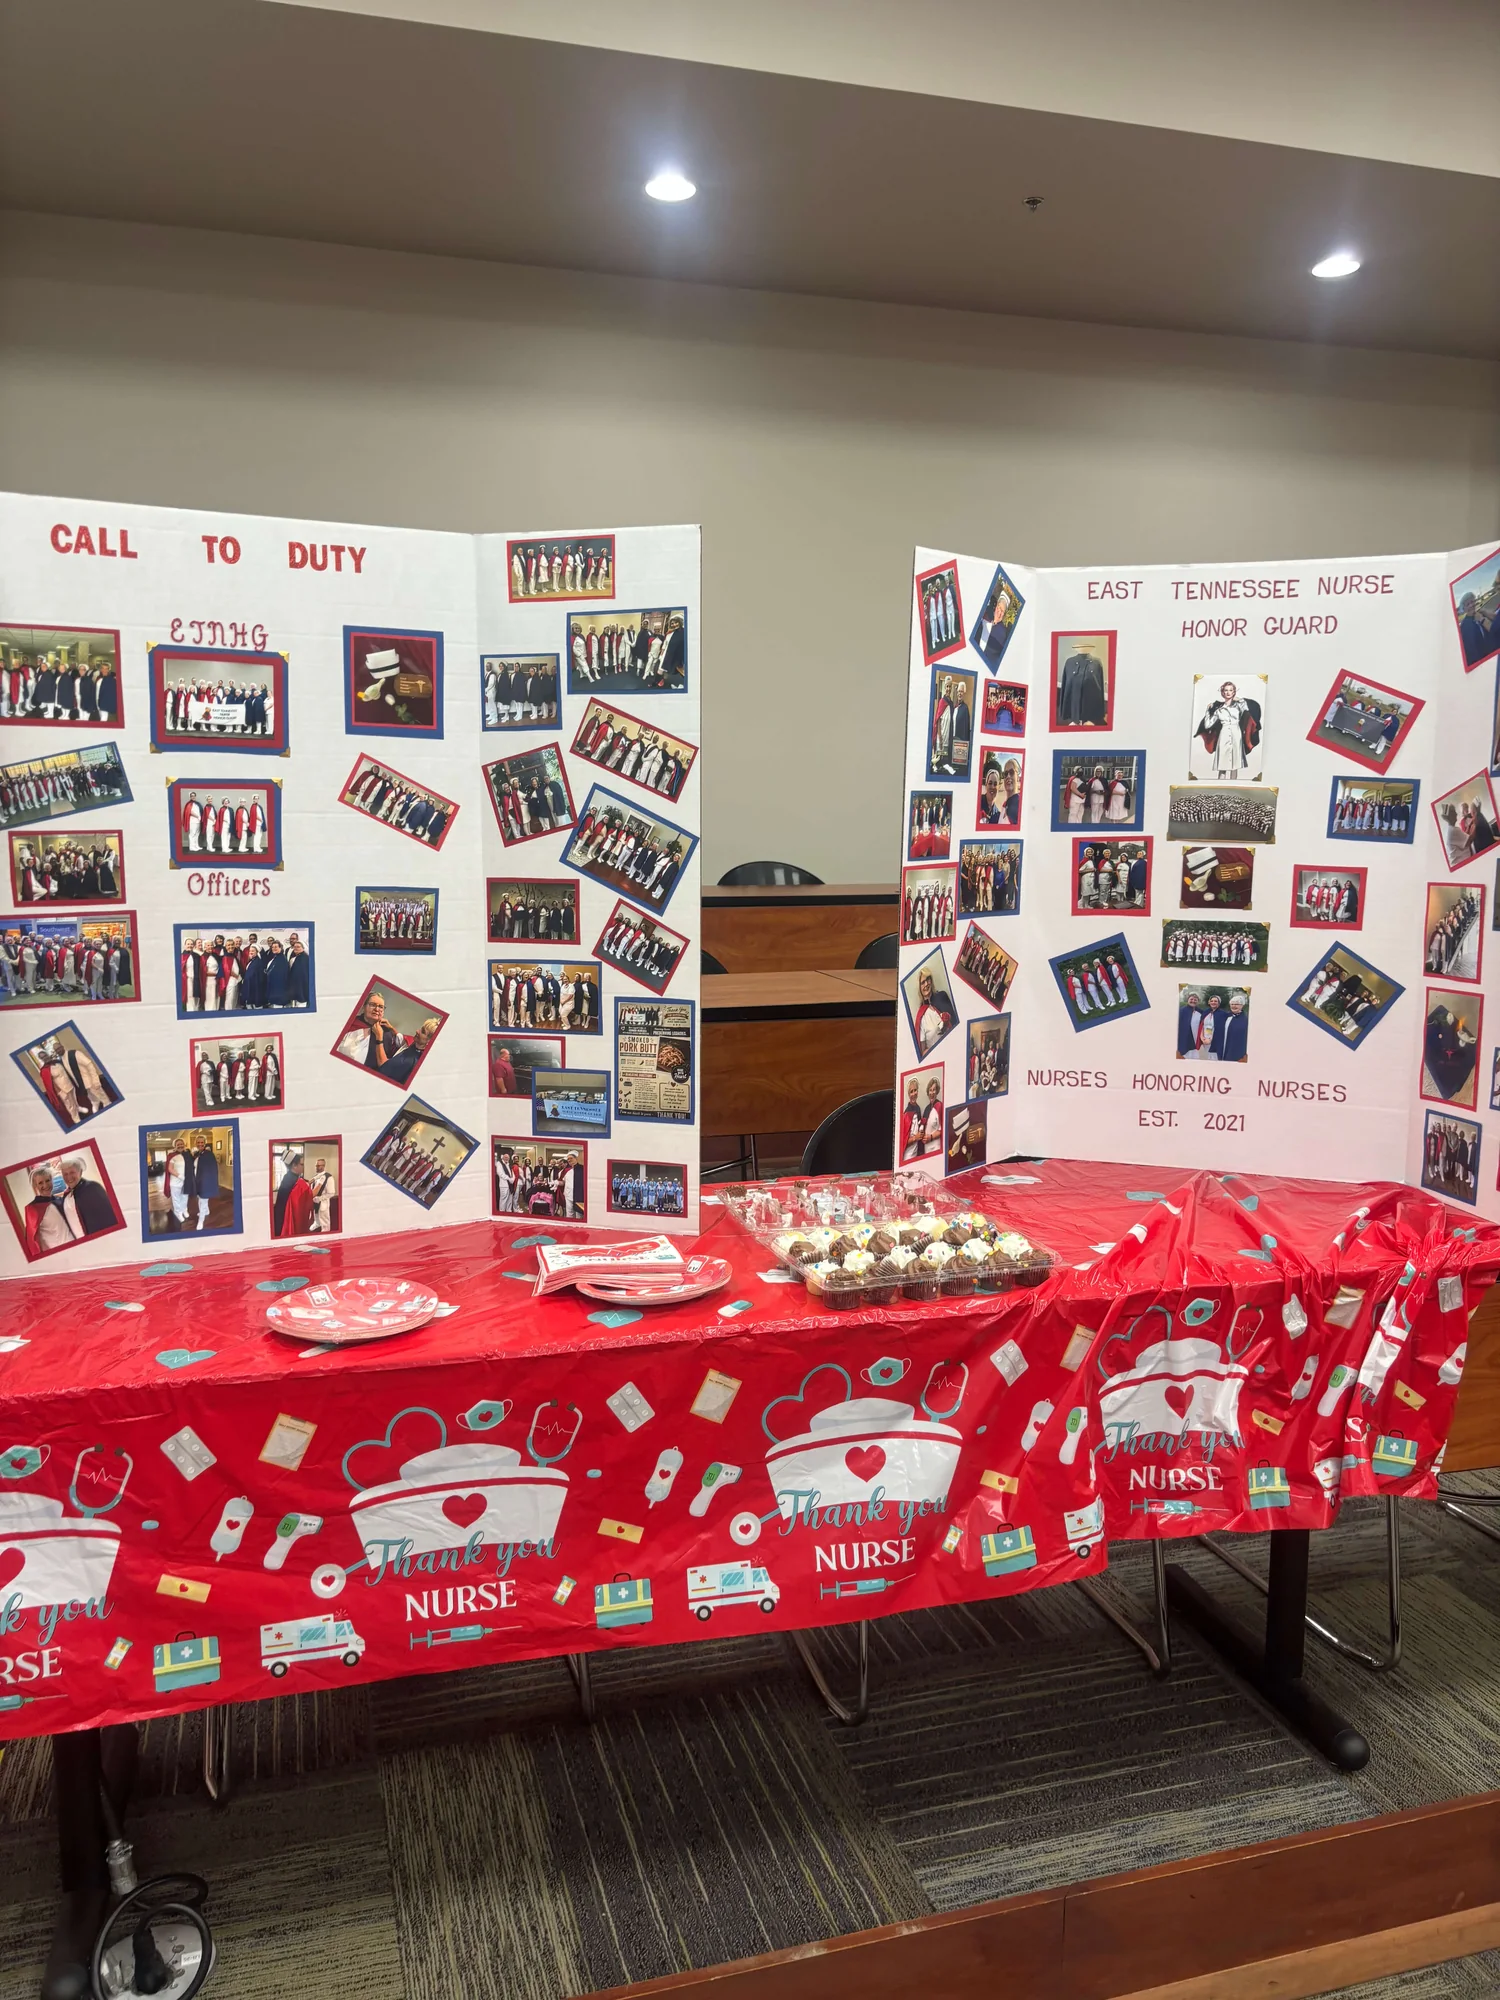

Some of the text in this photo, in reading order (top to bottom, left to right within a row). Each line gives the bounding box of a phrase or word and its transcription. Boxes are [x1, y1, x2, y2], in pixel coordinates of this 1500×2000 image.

[50, 523, 367, 574] CALL TO DUTY
[1087, 574, 1395, 601] EAST TENNESSEE NURSE
[170, 617, 269, 653] ETNHG
[1181, 615, 1338, 638] HONOR GUARD
[187, 871, 271, 897] Officers
[619, 1042, 657, 1053] PORK BUTT
[1027, 1069, 1347, 1103] NURSES HONORING NURSES
[1138, 1109, 1246, 1132] EST. 2021
[1103, 1418, 1246, 1464] Thank you
[1128, 1465, 1224, 1491] NURSE
[776, 1485, 949, 1537] Thank you
[363, 1530, 562, 1587] Thank you
[814, 1536, 917, 1573] NURSE
[404, 1578, 518, 1622] NURSE
[37, 1594, 115, 1646] you
